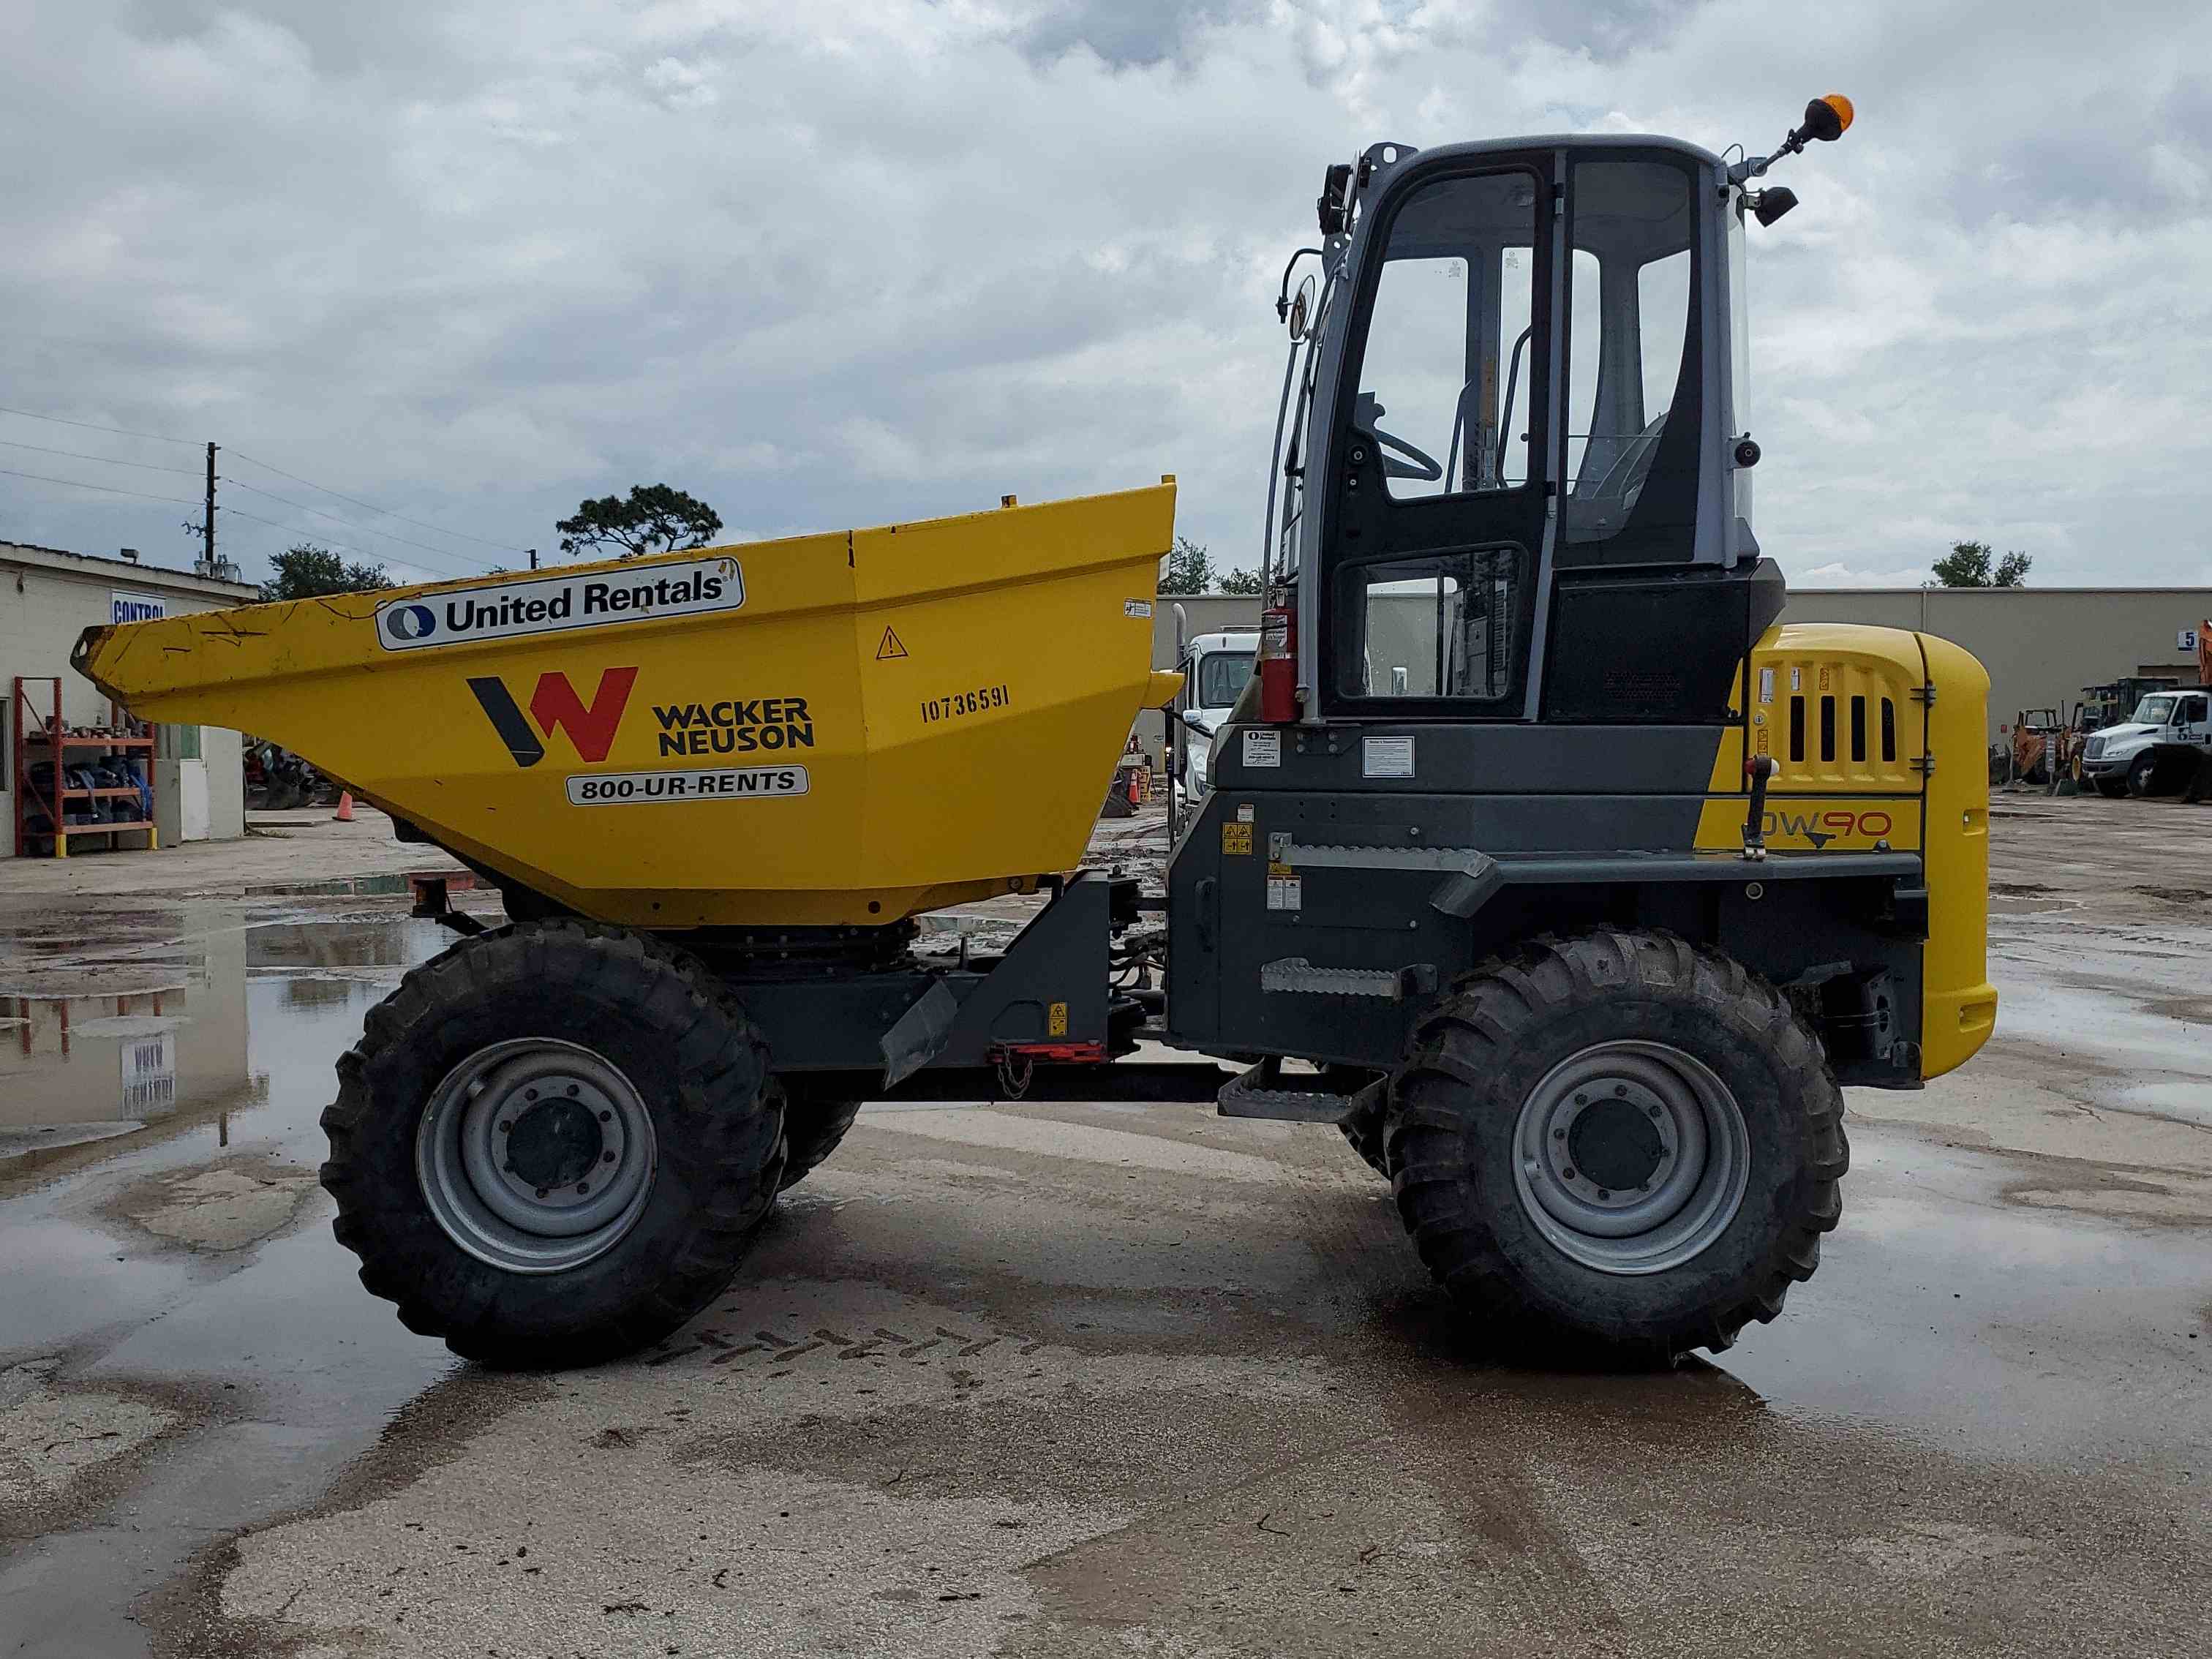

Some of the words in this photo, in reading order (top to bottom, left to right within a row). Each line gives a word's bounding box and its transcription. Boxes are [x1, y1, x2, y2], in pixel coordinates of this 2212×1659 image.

[447, 587, 572, 632] United
[584, 571, 723, 615] Rentals
[2186, 632, 2195, 647] 5
[652, 697, 813, 731] WACKER
[921, 684, 1009, 724] 10736591
[659, 723, 815, 757] NEUSON
[581, 772, 796, 800] 800-UR-RENTS
